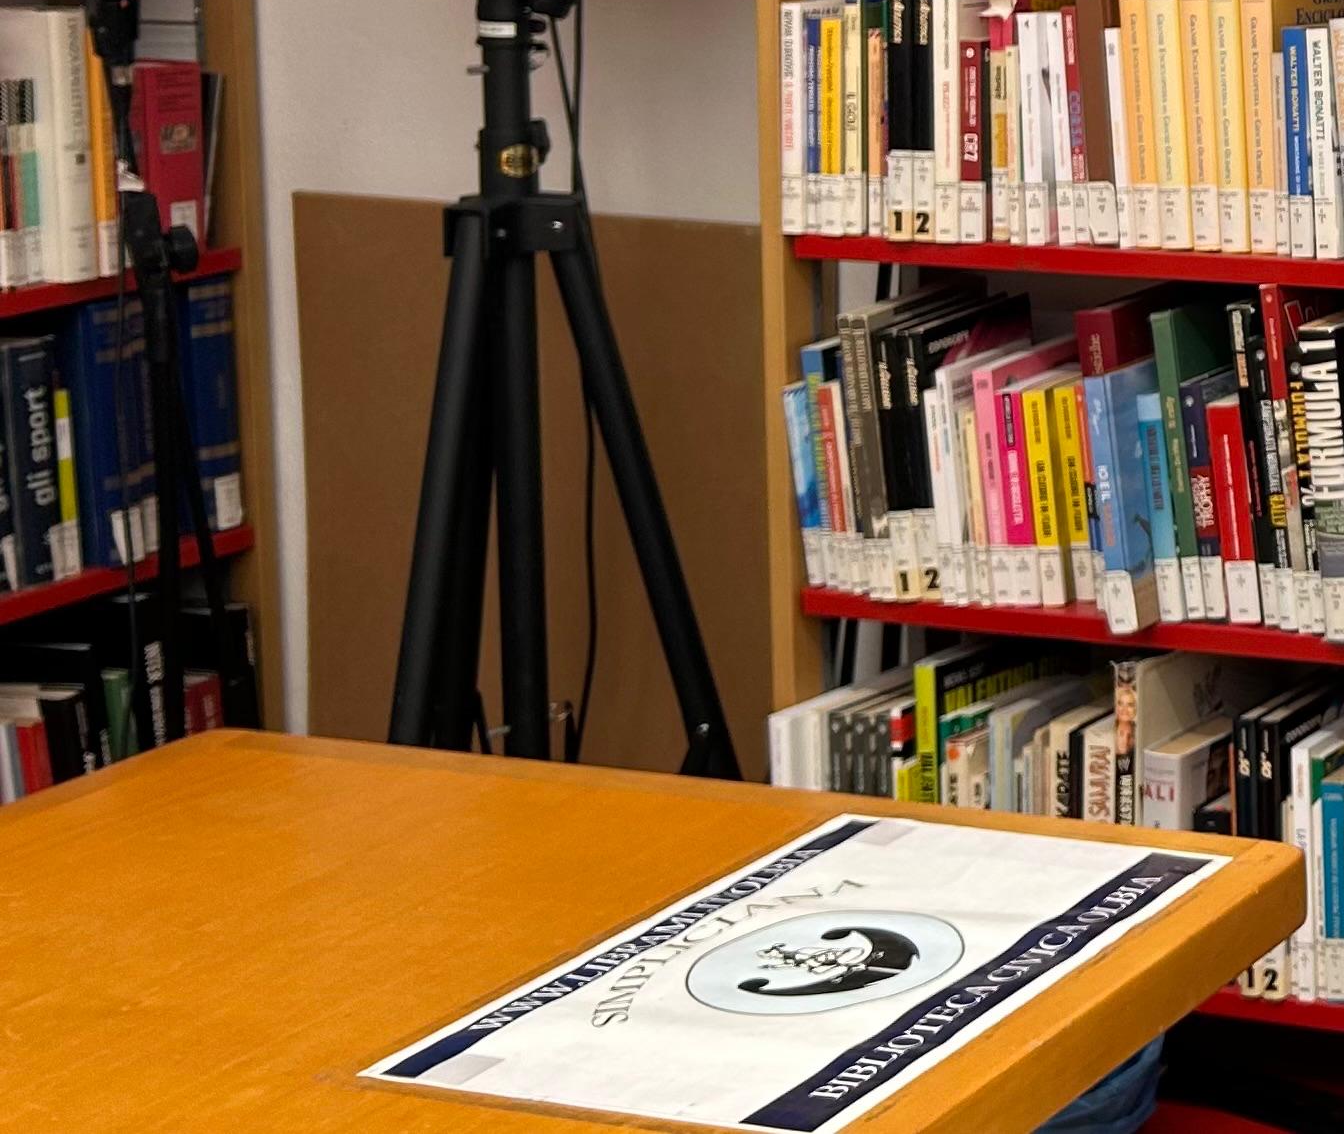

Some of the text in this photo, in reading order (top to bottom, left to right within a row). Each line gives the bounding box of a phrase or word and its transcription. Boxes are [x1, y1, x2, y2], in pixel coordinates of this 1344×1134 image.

[1311, 39, 1325, 140] WALTER BONATTI
[1299, 339, 1336, 353] 1
[28, 385, 50, 465] sport
[591, 879, 865, 1029] SIMPLICIANA
[809, 873, 1162, 1101] BIBLIOTECA CIVICA OLBIA
